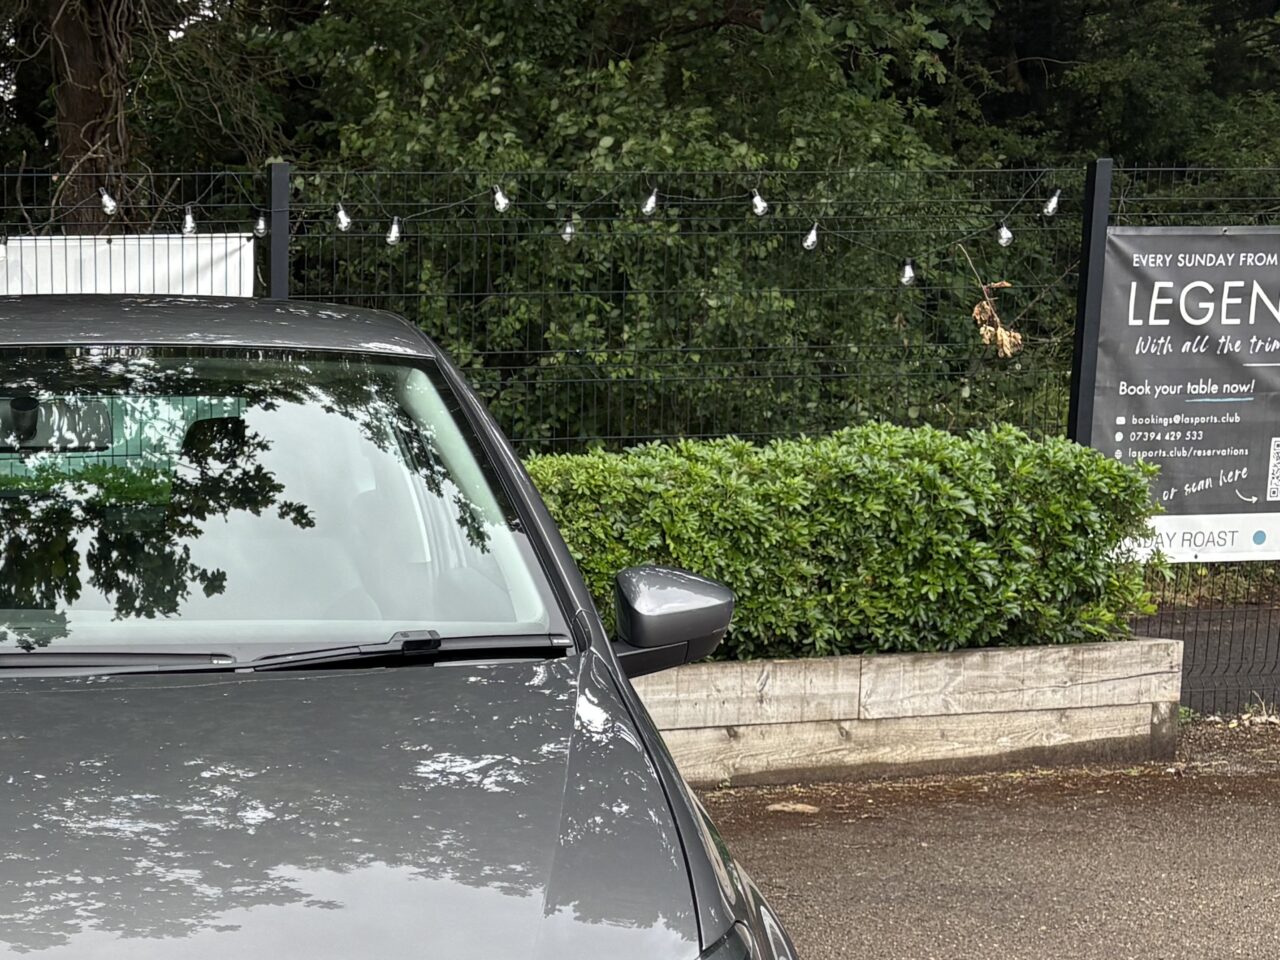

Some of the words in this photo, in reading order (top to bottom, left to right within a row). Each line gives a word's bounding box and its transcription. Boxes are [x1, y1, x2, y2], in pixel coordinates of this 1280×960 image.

[1132, 254, 1172, 267] EVERY
[1177, 253, 1235, 267] SUNDAY
[1239, 252, 1278, 267] FROM
[1128, 279, 1280, 326] LEGEN
[1135, 336, 1173, 356] With
[1181, 335, 1209, 353] all
[1216, 335, 1242, 355] the
[1119, 380, 1151, 395] Book
[1154, 385, 1183, 399] your
[1186, 378, 1219, 394] table
[1222, 379, 1255, 394] now!
[1131, 413, 1241, 427] bookings@lasports.club
[1129, 431, 1161, 442] 07394
[1164, 431, 1182, 441] 429
[1184, 430, 1204, 441] 533
[1128, 446, 1249, 460] lasports.club/reservations
[1162, 487, 1178, 501] or
[1184, 477, 1213, 496] scan
[1219, 467, 1248, 487] here
[1181, 530, 1239, 548] ROAST
